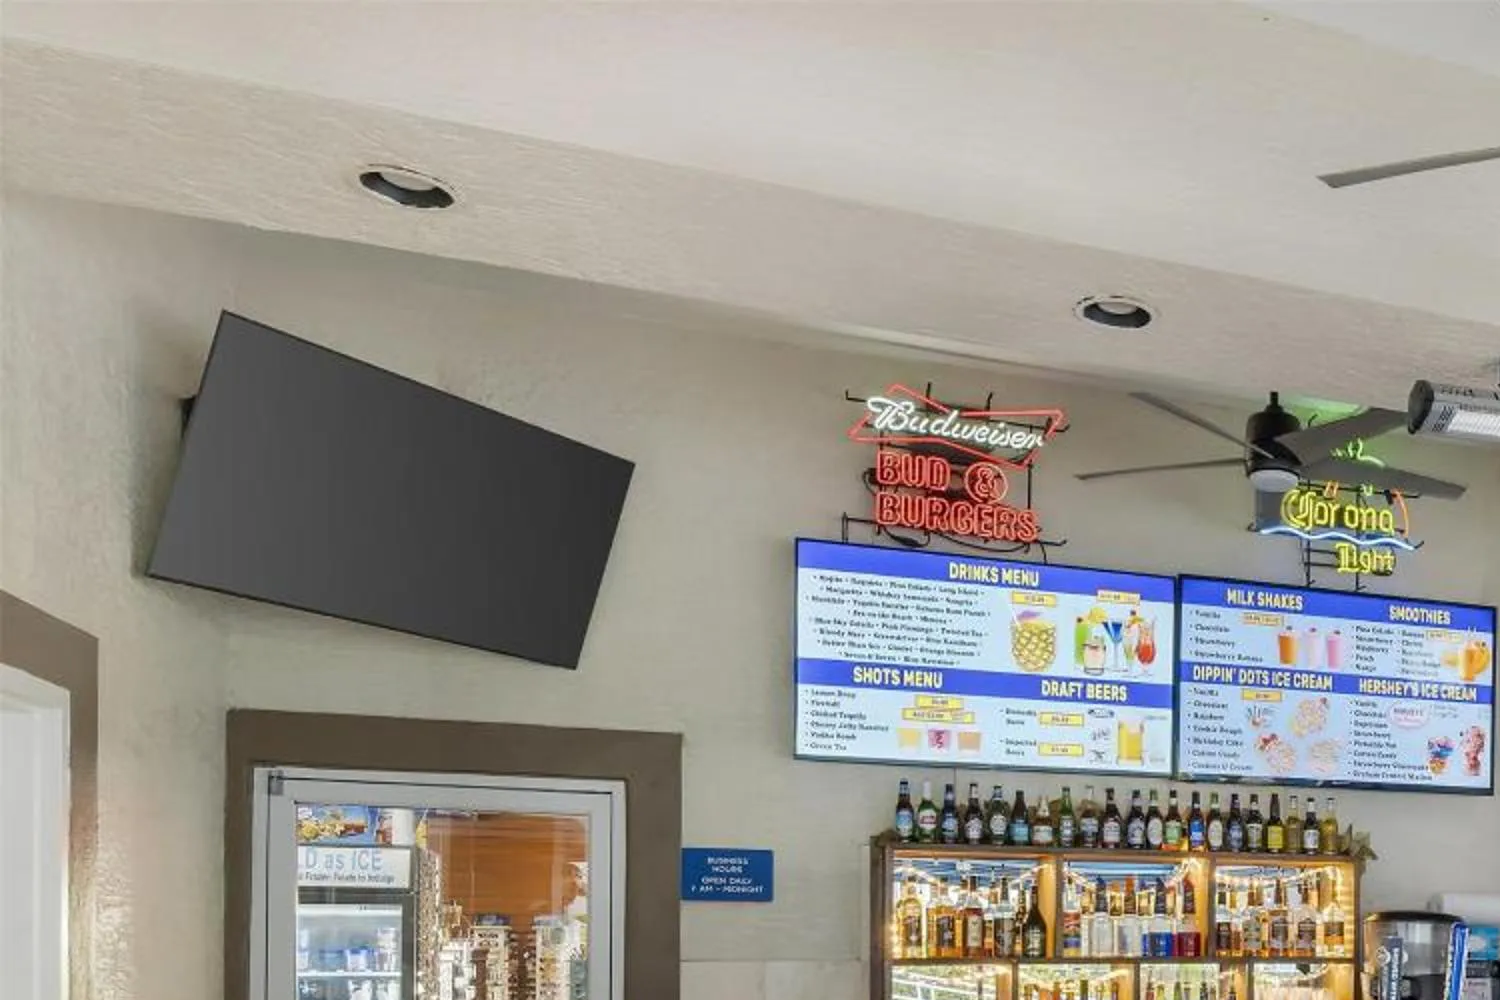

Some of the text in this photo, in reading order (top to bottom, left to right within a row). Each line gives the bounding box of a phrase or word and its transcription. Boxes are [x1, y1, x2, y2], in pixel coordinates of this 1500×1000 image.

[866, 396, 1045, 449] Budweiser
[876, 450, 951, 491] BUD
[876, 492, 1038, 541] BURGERS
[1280, 490, 1395, 535] Corona
[1335, 542, 1395, 573] Light
[949, 561, 1039, 587] DRINKS MENU
[1226, 588, 1303, 610] MILK SHAKES
[1389, 604, 1451, 625] SMOOTHIES
[853, 665, 943, 688] SHOTS MENU
[1193, 665, 1333, 691] DIPPIN' DOTS ICE CREAM
[1359, 677, 1477, 701] HERSHEY'S ICE CREAM
[1041, 679, 1127, 702] DRAFT BEERS
[352, 849, 383, 870] ICE
